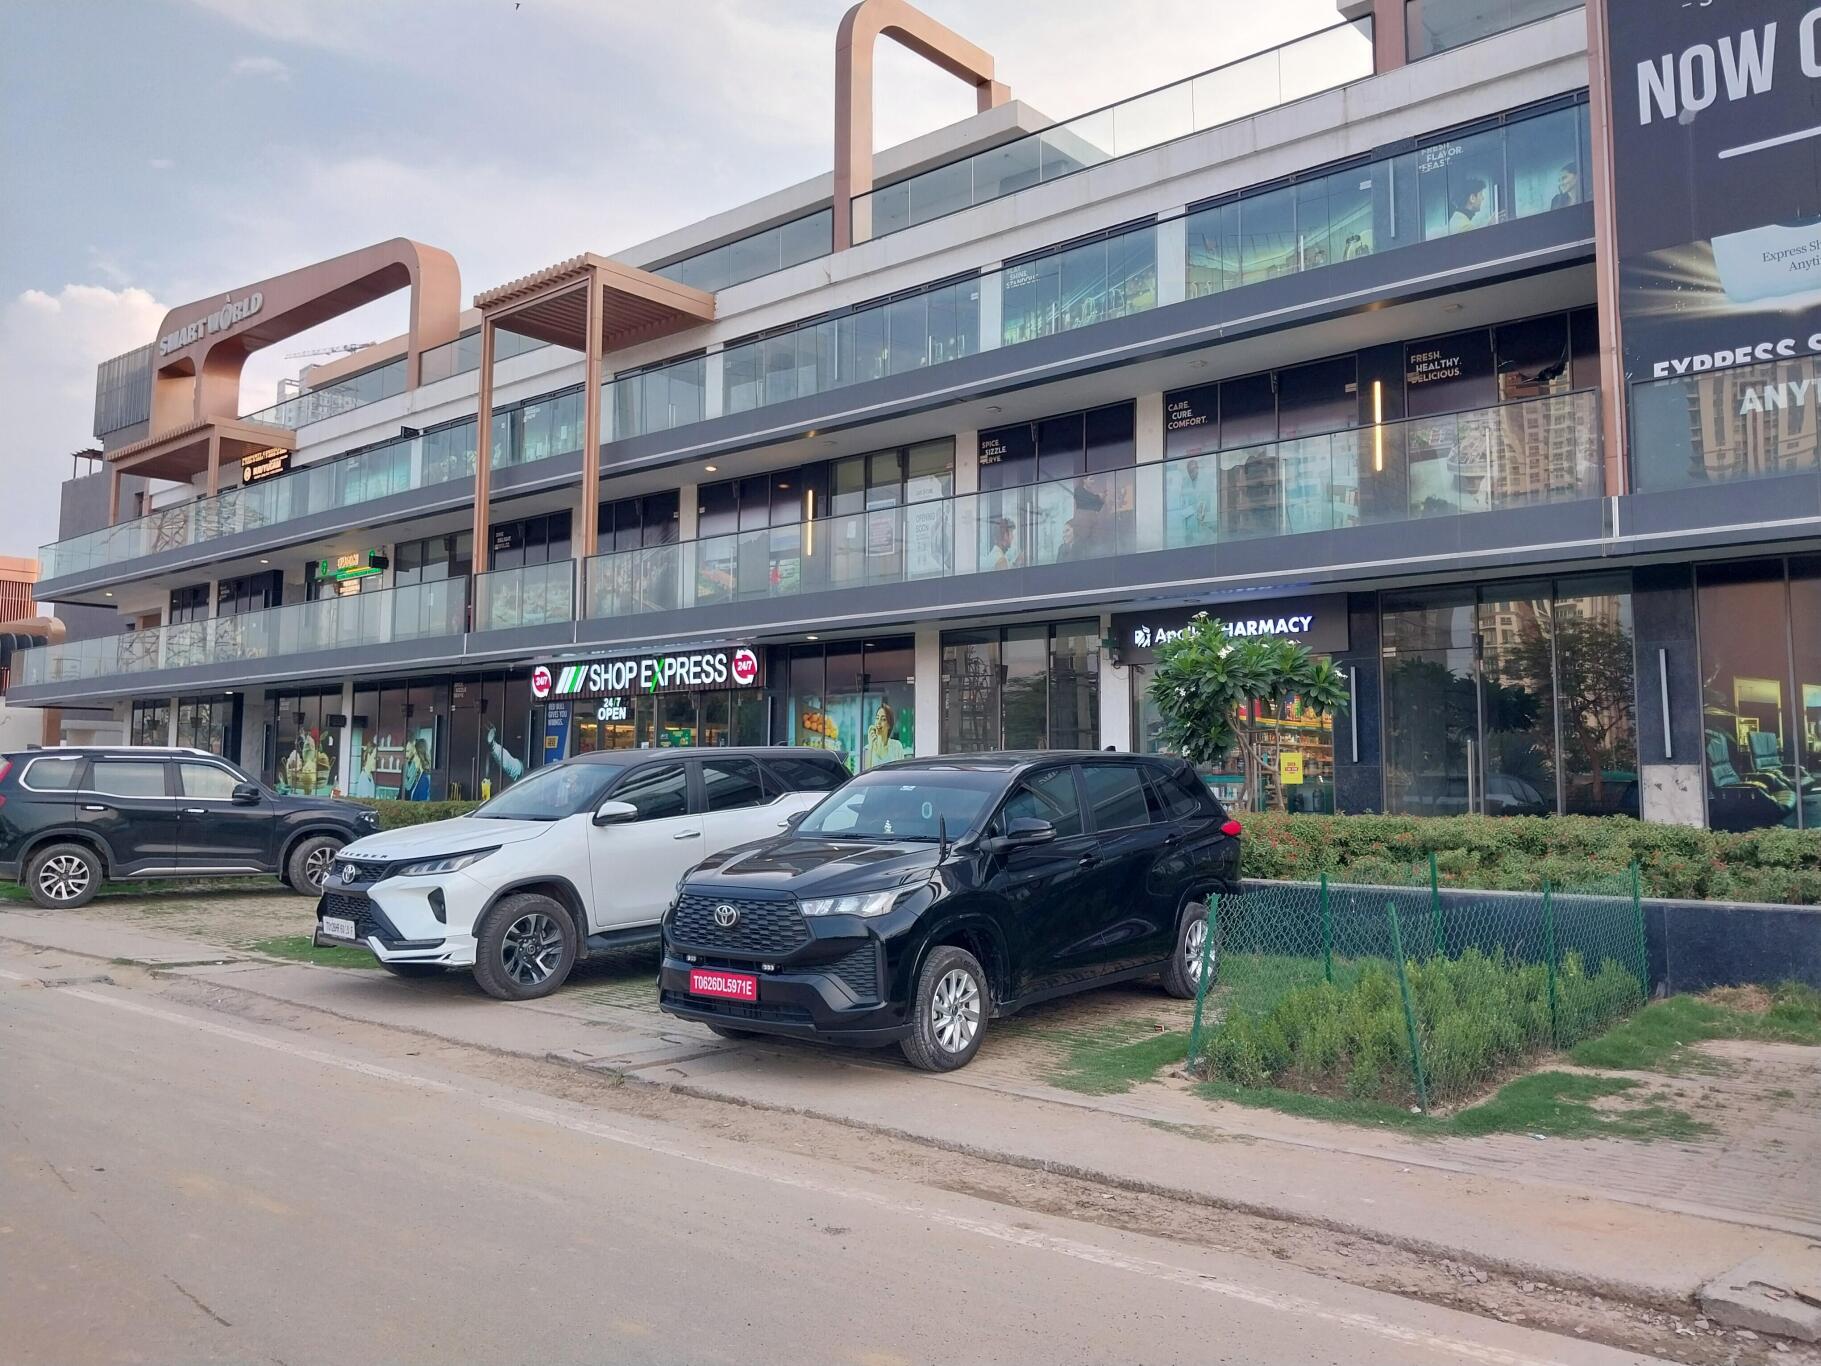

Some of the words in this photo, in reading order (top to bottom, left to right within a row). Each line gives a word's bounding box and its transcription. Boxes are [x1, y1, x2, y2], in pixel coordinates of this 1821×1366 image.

[1637, 22, 1777, 126] NOW
[1762, 246, 1807, 262] Express
[160, 317, 207, 356] SMART
[208, 293, 263, 335] WORLD
[1410, 350, 1442, 364] FRESH.
[1416, 357, 1462, 372] HEALTHY.
[1168, 415, 1208, 430] COMFORT.
[1220, 616, 1312, 637] HARMACY
[589, 660, 638, 692] SHOP
[640, 653, 727, 694] EXPRESS
[736, 661, 752, 671] 24/7
[603, 697, 621, 708] 24/7
[597, 706, 626, 720] OPEN
[693, 975, 752, 995] T0626DL5971E
